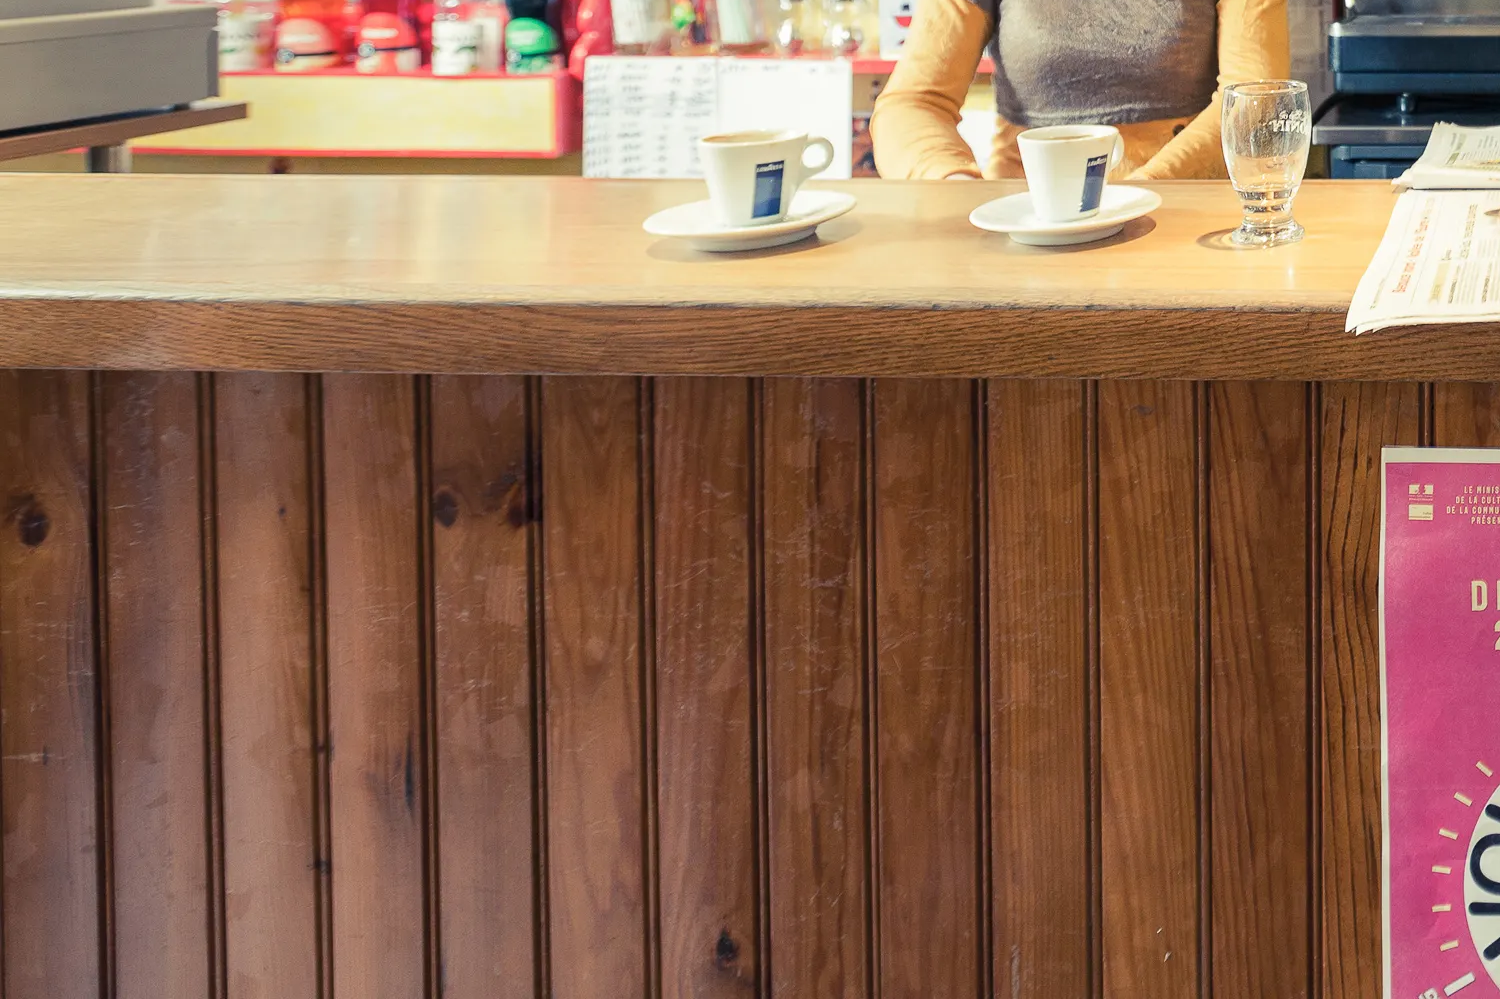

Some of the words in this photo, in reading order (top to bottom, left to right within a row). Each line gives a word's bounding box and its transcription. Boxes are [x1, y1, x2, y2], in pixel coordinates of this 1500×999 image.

[1464, 486, 1473, 494] LE
[1455, 496, 1465, 504] DE
[1468, 496, 1478, 504] LA
[1446, 506, 1456, 514] DE
[1459, 506, 1469, 514] LA
